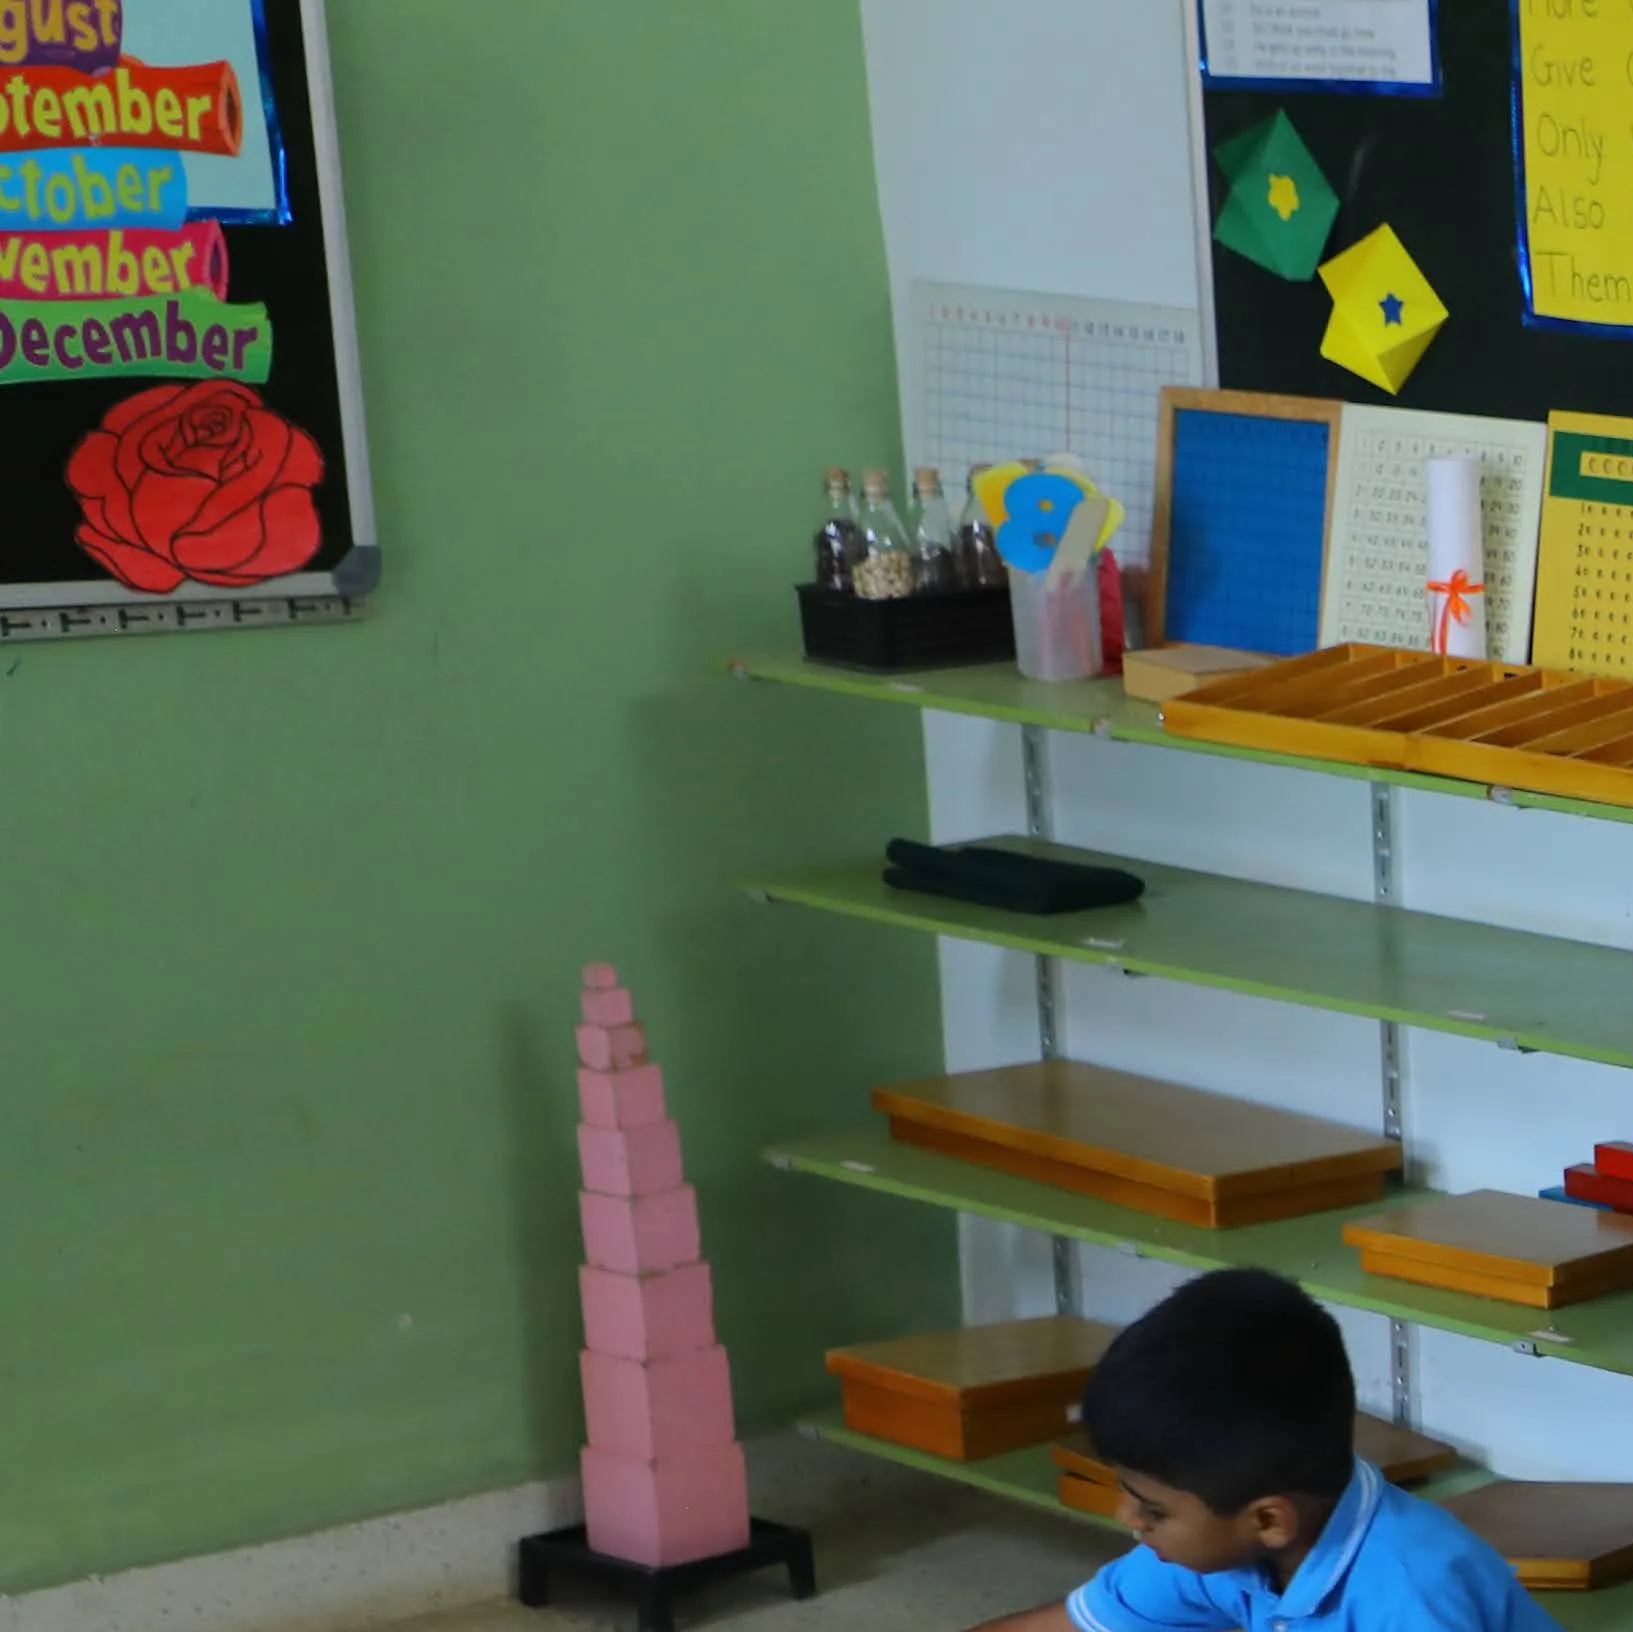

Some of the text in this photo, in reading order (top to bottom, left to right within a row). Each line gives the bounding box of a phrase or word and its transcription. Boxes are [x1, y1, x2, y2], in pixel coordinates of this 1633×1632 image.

[1531, 42, 1597, 87] Give
[0, 68, 211, 141] tember
[1537, 112, 1604, 185] Only
[1532, 185, 1605, 230] Also
[1535, 252, 1632, 302] Them
